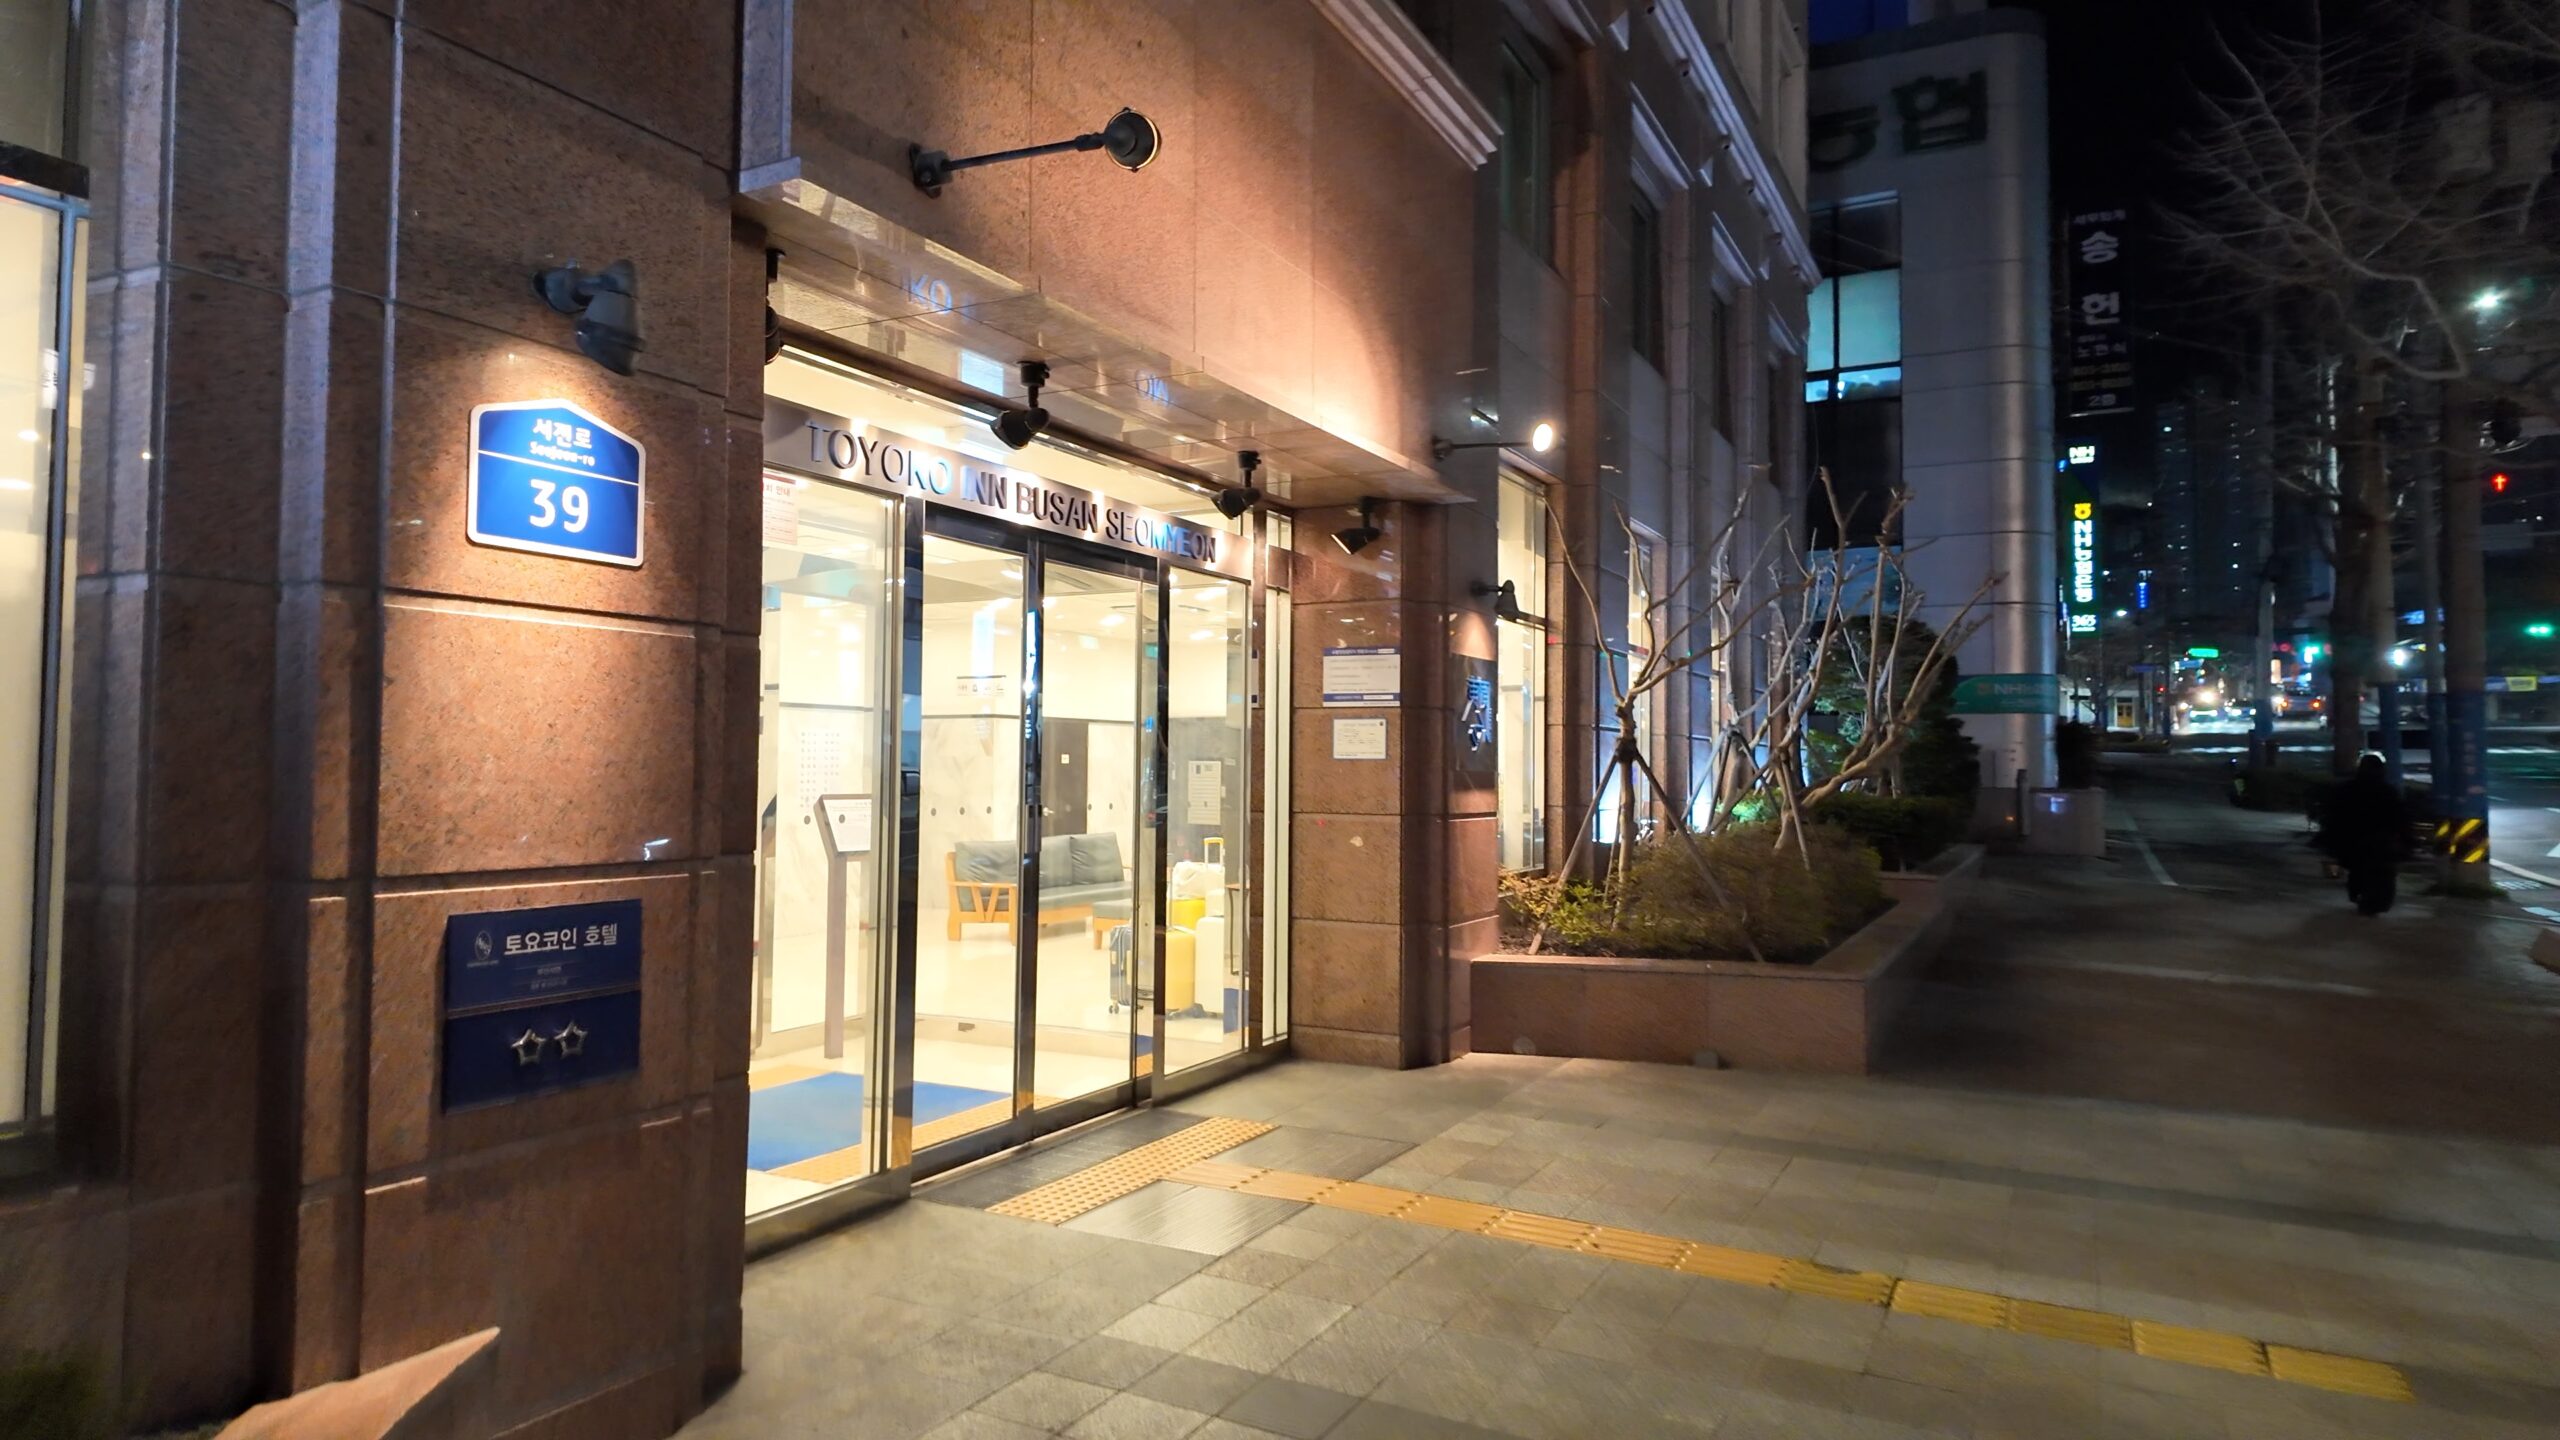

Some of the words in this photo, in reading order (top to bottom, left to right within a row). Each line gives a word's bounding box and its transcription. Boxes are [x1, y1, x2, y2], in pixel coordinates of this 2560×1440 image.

[529, 479, 589, 534] 39
[806, 420, 951, 495] TOYOKO
[961, 464, 1008, 511] INN
[1015, 481, 1099, 534] BUSAN
[1106, 508, 1217, 564] SEOMYEON
[2071, 614, 2097, 627] 365
[503, 927, 577, 956] 토요코인
[583, 923, 618, 947] 호텔
